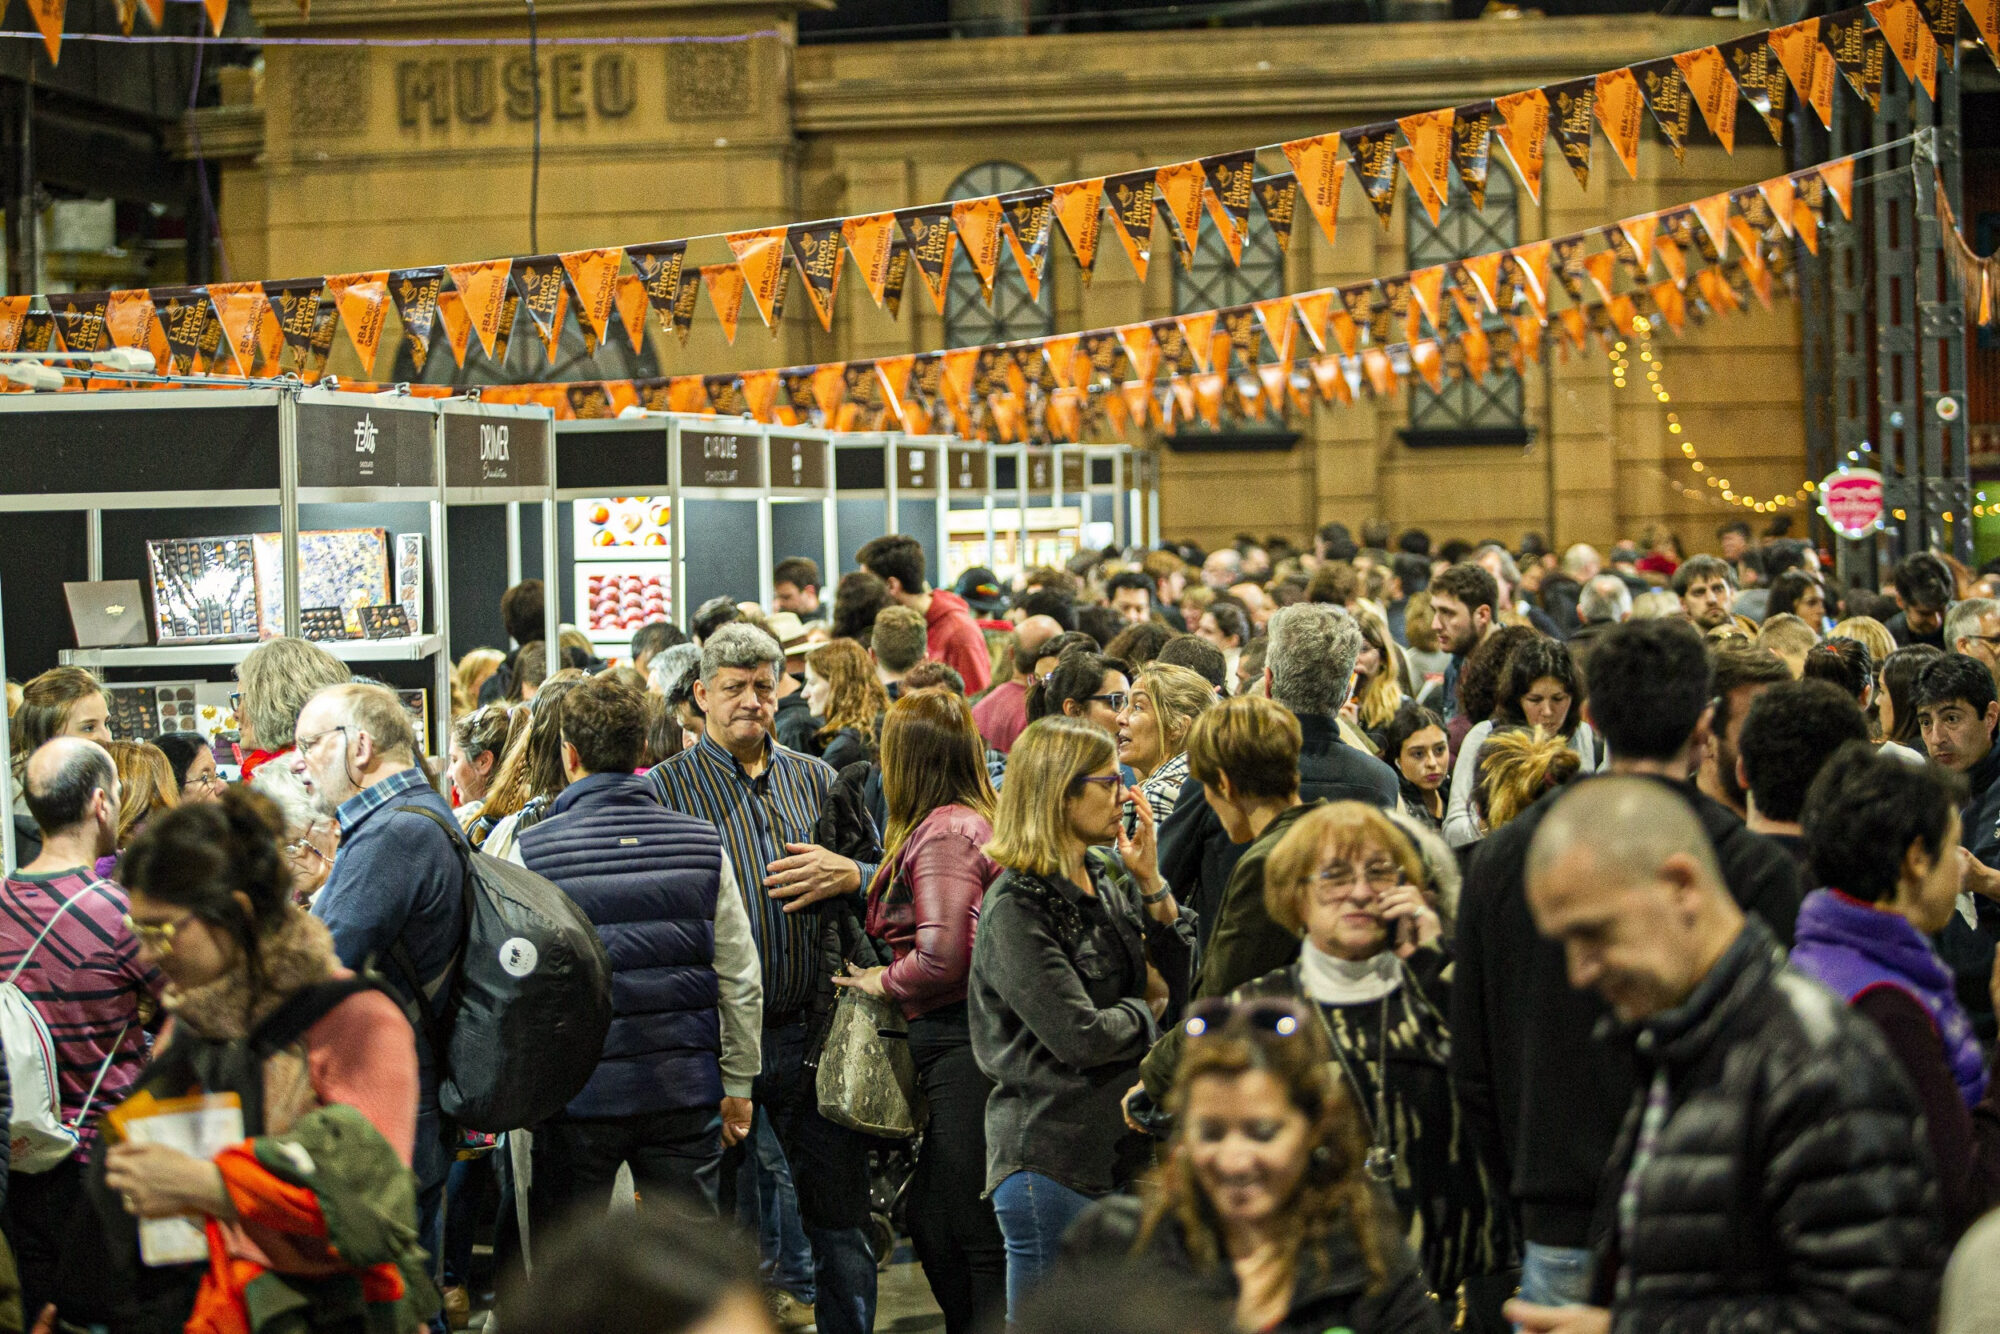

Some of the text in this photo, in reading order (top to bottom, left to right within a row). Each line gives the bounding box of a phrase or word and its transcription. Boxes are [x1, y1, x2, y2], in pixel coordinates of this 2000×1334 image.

[1844, 27, 1853, 63] CHOCO
[1852, 18, 1863, 63] LATERIE
[1903, 5, 1913, 60] #BACapital
[1750, 52, 1758, 88] CHOCO
[1757, 43, 1767, 88] LATERIE
[1800, 35, 1810, 90] #BACapital
[1836, 47, 1844, 62] LA
[1865, 48, 1874, 83] CHOCO
[1873, 39, 1885, 84] LATERIE
[397, 52, 637, 126] MUSEO
[1661, 76, 1671, 112] CHOCO
[1669, 67, 1681, 113] LATERIE
[1707, 58, 1719, 113] #BACapital
[1741, 72, 1750, 88] LA
[1572, 97, 1583, 133] CHOCO
[1580, 89, 1593, 134] LATERIE
[1619, 82, 1633, 138] #BACapital
[1653, 95, 1661, 110] LA
[1468, 121, 1479, 158] CHOCO
[1477, 113, 1489, 159] LATERIE
[1528, 103, 1542, 159] #BACapital
[1563, 118, 1573, 132] LA
[1371, 141, 1384, 178] CHOCO
[1379, 133, 1395, 179] LATERIE
[1460, 142, 1469, 157] LA
[1231, 170, 1242, 207] CHOCO
[1239, 162, 1253, 208] LATERIE
[1317, 150, 1330, 206] #BACapital
[1363, 162, 1373, 177] LA
[1132, 190, 1143, 226] CHOCO
[1140, 181, 1154, 228] LATERIE
[1185, 174, 1198, 230] #BACapital
[1224, 190, 1232, 205] LA
[1020, 227, 1029, 242] LA
[1027, 206, 1041, 244] CHOCO
[1080, 194, 1095, 250] #BACapital
[1124, 210, 1133, 225] LA
[824, 231, 839, 279] LATERIE
[870, 226, 886, 283] #BACapital
[917, 245, 926, 260] LA
[925, 224, 938, 261] CHOCO
[933, 216, 950, 263] LATERIE
[981, 210, 996, 265] #BACapital
[666, 253, 683, 300] LATERIE
[760, 243, 776, 299] #BACapital
[807, 259, 817, 275] LA
[816, 240, 828, 277] CHOCO
[537, 273, 551, 312] CHOCO
[545, 265, 563, 313] LATERIE
[594, 262, 612, 320] #BACapital
[650, 282, 659, 297] LA
[657, 260, 671, 298] CHOCO
[292, 297, 308, 335] CHOCO
[301, 289, 321, 338] LATERIE
[404, 308, 416, 323] LA
[414, 286, 428, 324] CHOCO
[422, 279, 440, 326] LATERIE
[481, 275, 500, 333] #BACapital
[528, 294, 538, 310] LA
[68, 332, 79, 346] LA
[76, 311, 93, 349] CHOCO
[85, 303, 106, 351] LATERIE
[169, 326, 181, 342] LA
[179, 305, 196, 344] CHOCO
[187, 299, 208, 347] LATERIE
[283, 317, 295, 333] LA
